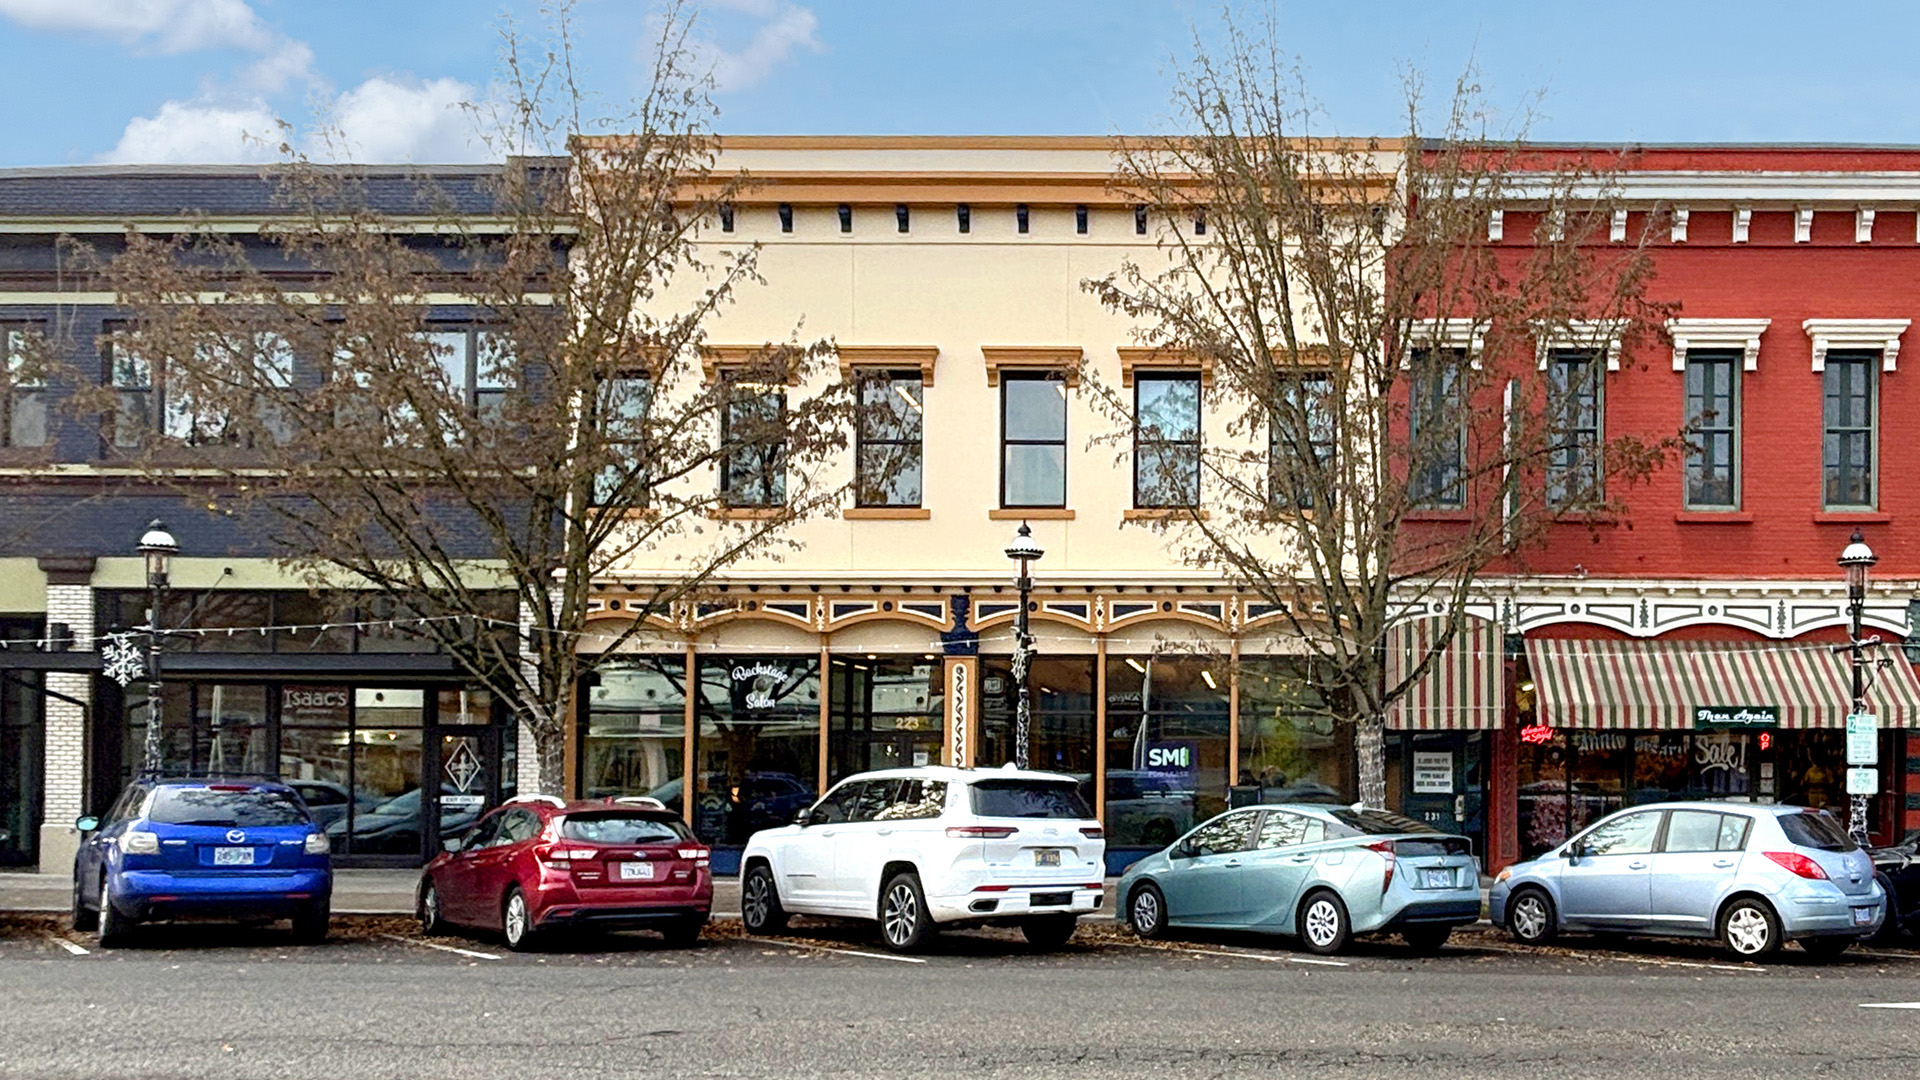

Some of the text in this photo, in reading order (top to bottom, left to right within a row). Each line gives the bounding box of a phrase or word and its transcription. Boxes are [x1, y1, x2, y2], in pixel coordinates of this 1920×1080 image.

[732, 661, 788, 684] Backstage
[284, 690, 347, 708] Isaac's
[745, 693, 776, 709] Salon
[895, 717, 919, 729] 223
[1697, 709, 1775, 724] Then Again
[1694, 735, 1746, 773] Sale!
